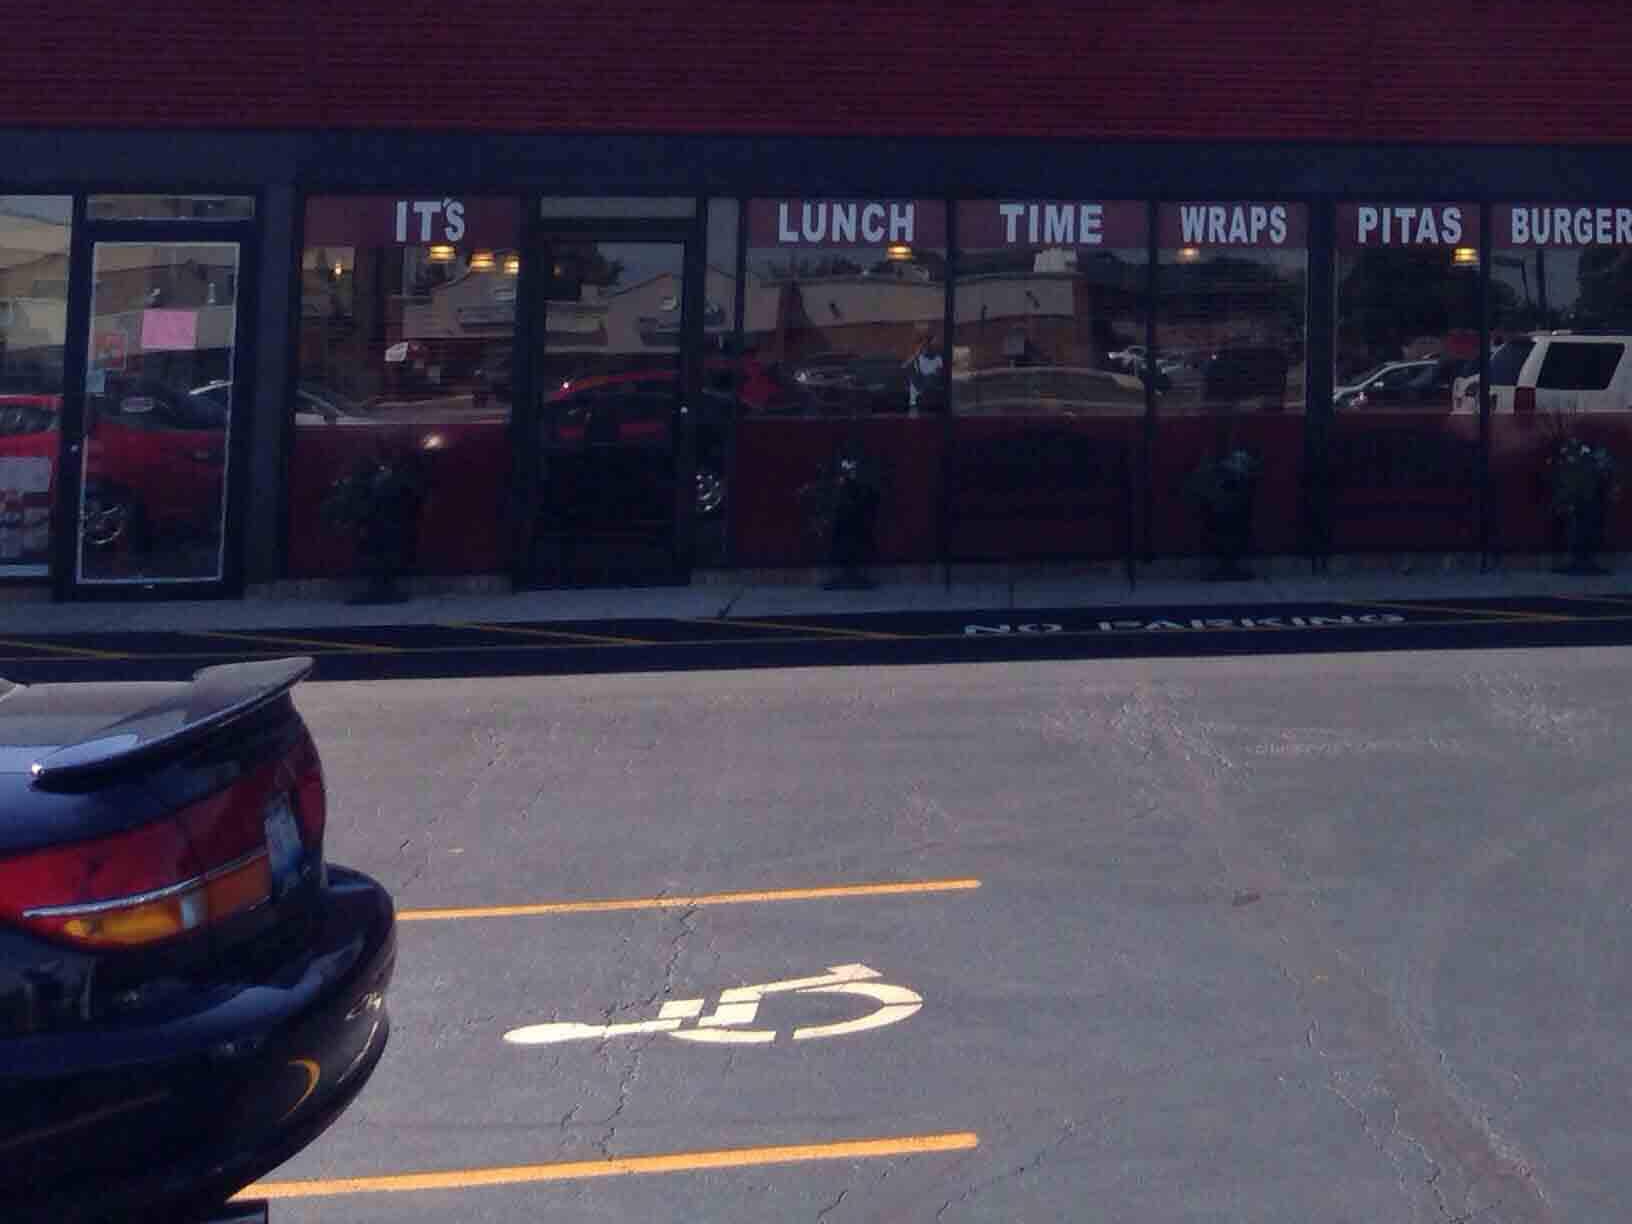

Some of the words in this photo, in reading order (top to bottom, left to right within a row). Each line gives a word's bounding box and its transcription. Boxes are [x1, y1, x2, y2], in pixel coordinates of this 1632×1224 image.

[395, 197, 465, 242] IT'S
[778, 201, 915, 244] LUNCH
[999, 203, 1104, 245] TIME
[1180, 205, 1288, 245] WRAPS
[1357, 207, 1463, 245] PITAS
